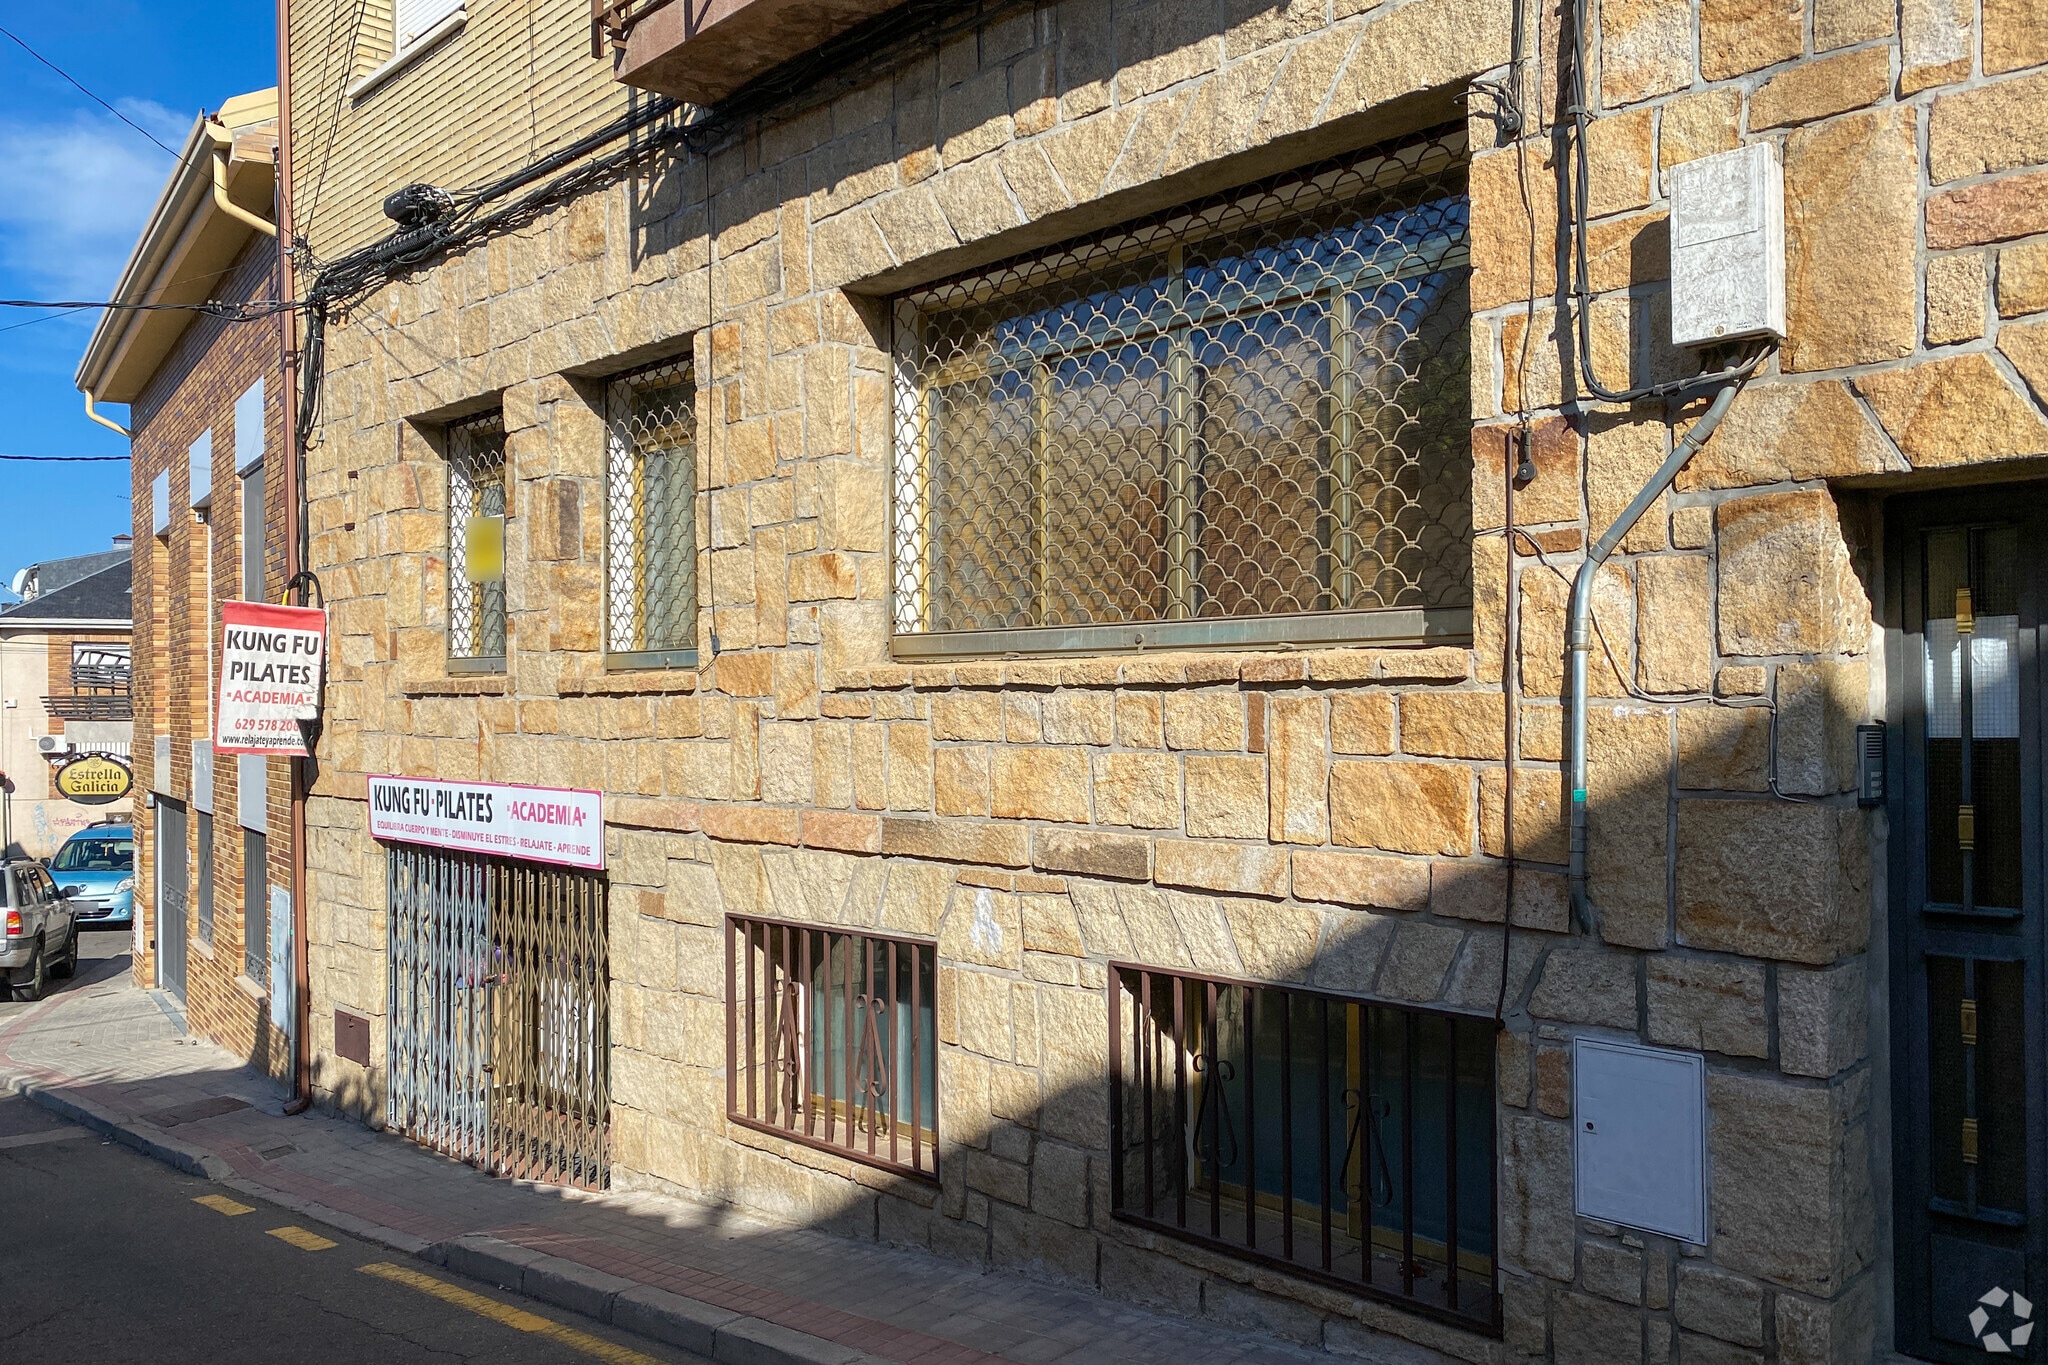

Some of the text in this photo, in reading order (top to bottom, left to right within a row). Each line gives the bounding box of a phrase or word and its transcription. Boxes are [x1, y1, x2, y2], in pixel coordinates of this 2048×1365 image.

[226, 629, 319, 655] KUNG FU
[230, 661, 310, 684] PILATES
[232, 690, 305, 704] ACADEMIA
[235, 718, 255, 730] 629
[258, 720, 277, 731] 578
[222, 734, 304, 747] www.relajateyaprende.co
[69, 768, 121, 780] Estrella
[71, 780, 119, 792] Galicia
[374, 785, 493, 823] KUNG FU PILATES
[510, 801, 582, 827] ACADEMIA
[377, 820, 404, 832] EQUILIBRA
[404, 823, 425, 834] CUERPO
[425, 827, 430, 835] Y
[430, 828, 449, 838] MENTE
[451, 830, 484, 843] DISMINUYE
[485, 833, 493, 843] EL
[520, 837, 553, 851] RELAJATE
[557, 842, 591, 856] APRENDE
